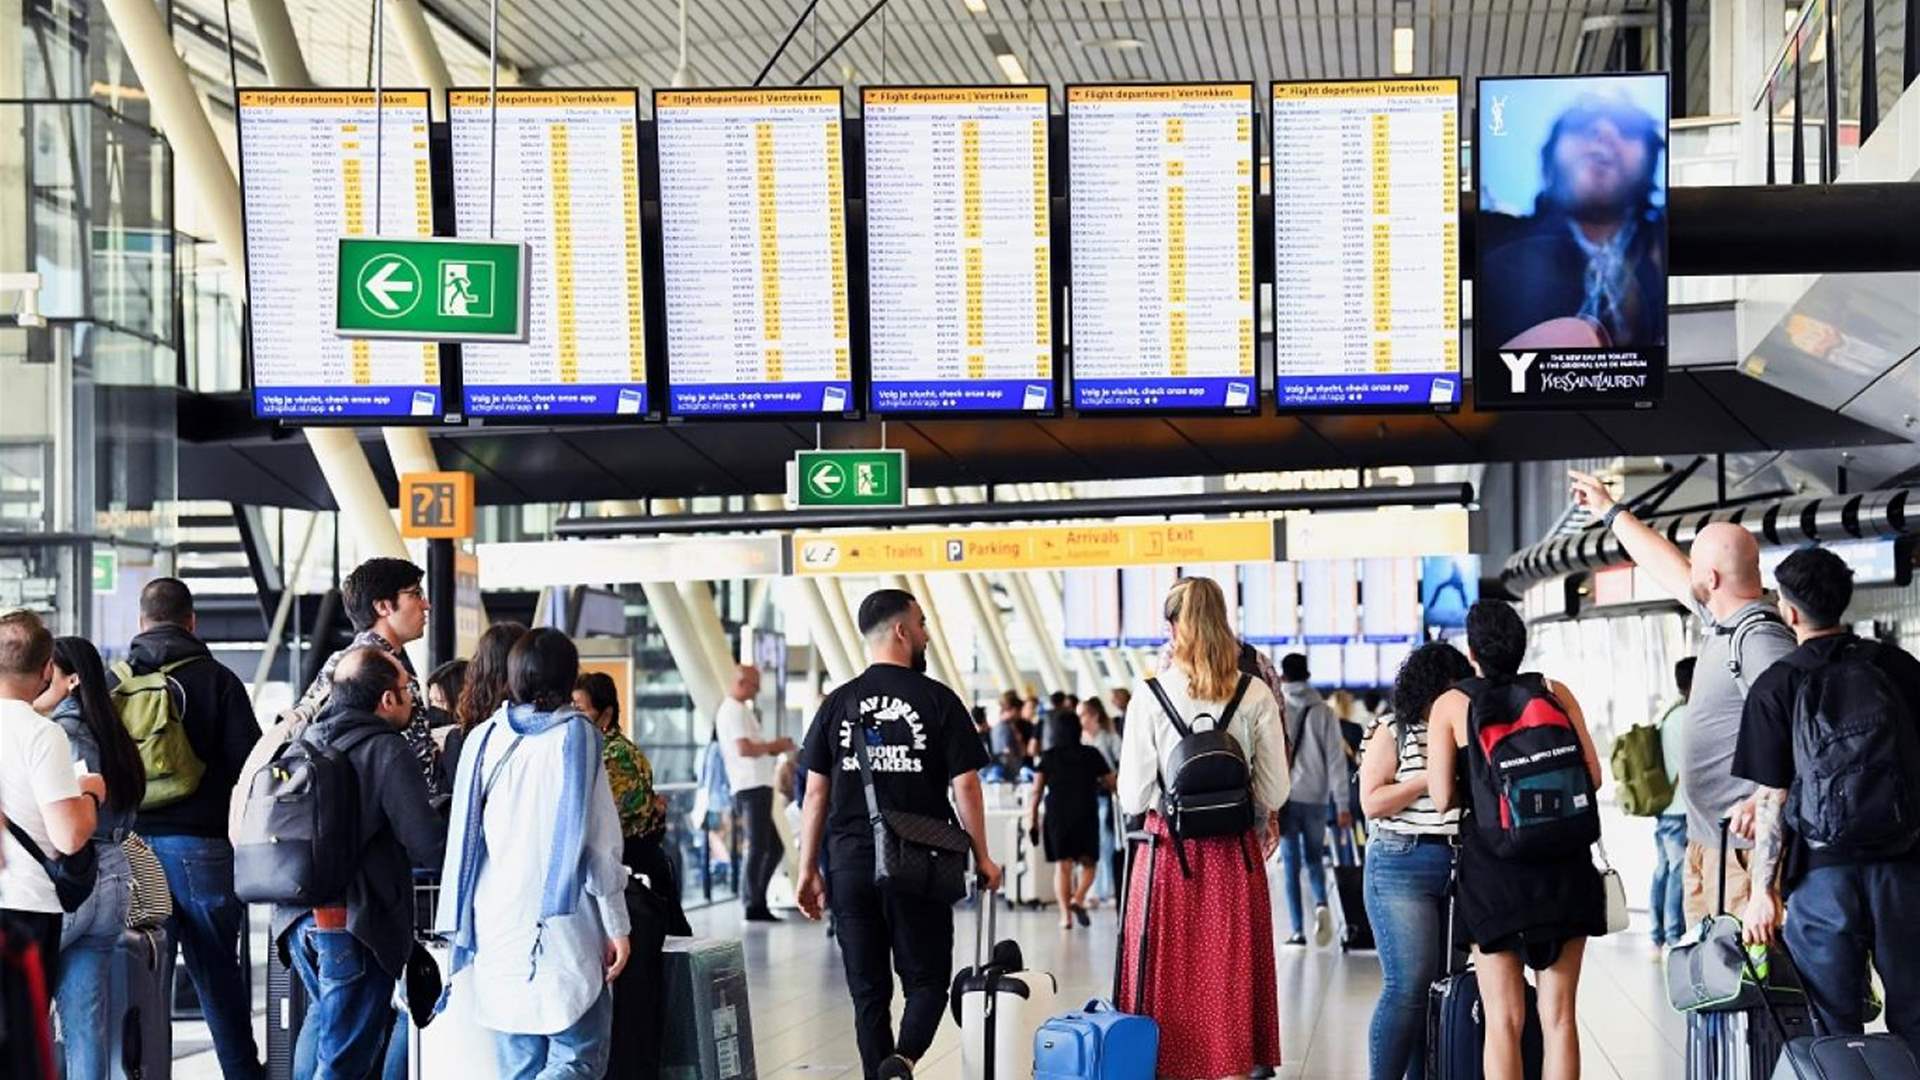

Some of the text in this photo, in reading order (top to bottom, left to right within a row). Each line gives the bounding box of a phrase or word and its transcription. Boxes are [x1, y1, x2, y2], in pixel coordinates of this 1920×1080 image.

[880, 91, 1029, 102] Flight departures Vertrekken
[1084, 88, 1233, 100] Flight departures Vertrekken
[1289, 84, 1440, 97] Flight departures Vertrekken
[257, 95, 287, 106] Flight
[288, 95, 343, 105] departures
[498, 95, 553, 105] departures
[561, 94, 617, 103] Vertrekken
[672, 94, 822, 105] Flight departures Vertrekken
[1499, 353, 1539, 393] Y
[1066, 529, 1120, 545] Arrivals
[1167, 528, 1195, 541] Exit
[884, 544, 923, 559] Trains
[968, 541, 1020, 558] Parking
[890, 697, 927, 750] DREAM
